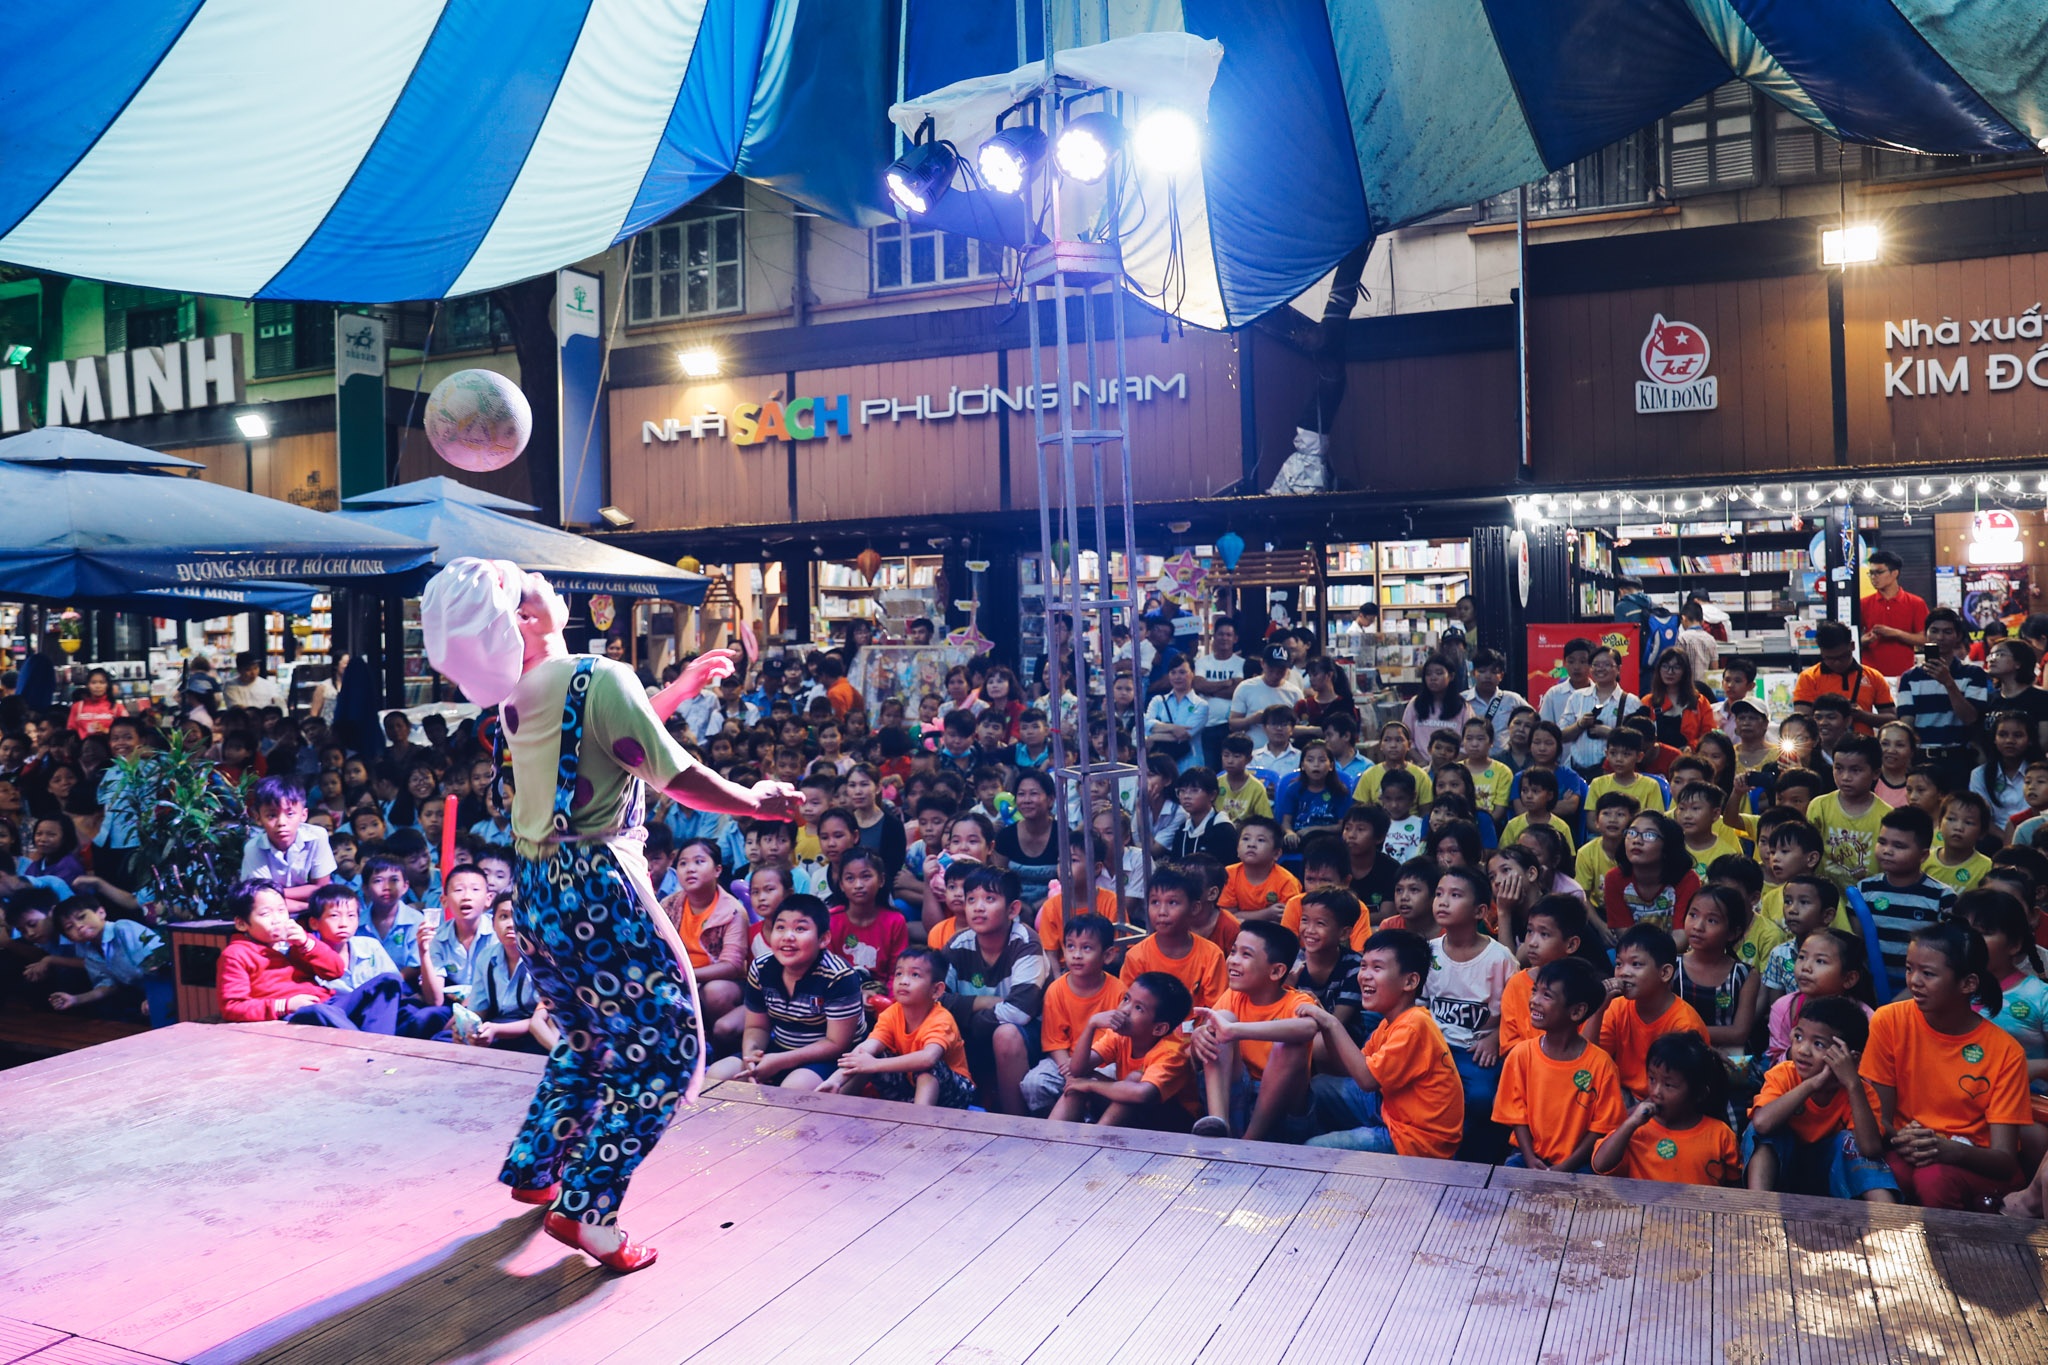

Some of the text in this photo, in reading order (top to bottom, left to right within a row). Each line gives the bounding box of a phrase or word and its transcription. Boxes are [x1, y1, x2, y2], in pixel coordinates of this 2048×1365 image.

[1884, 302, 2048, 349] Nhà xuấ
[47, 333, 236, 426] MINH
[1884, 356, 1969, 398] KIM
[642, 373, 1186, 446] NHÀ SÁCH PHƯƠNG NAM
[1640, 384, 1668, 410] KIM
[280, 558, 299, 575] TP.
[350, 558, 387, 574] MINH
[203, 587, 246, 603] MINH
[1600, 633, 1618, 646] Big
[1488, 700, 1500, 717] NEW
